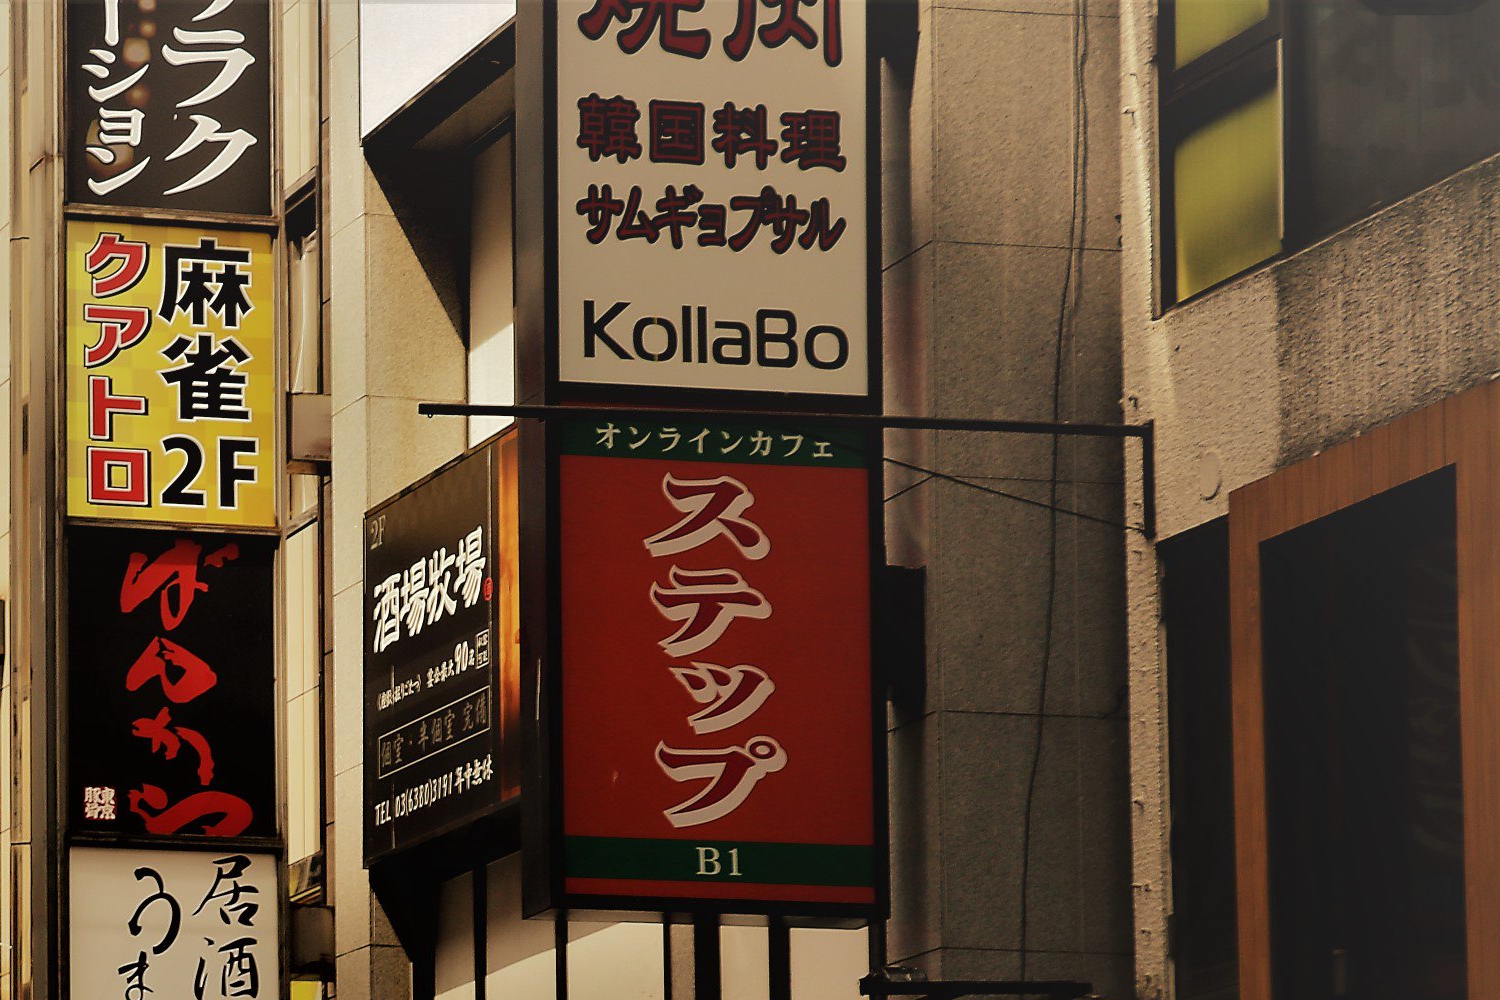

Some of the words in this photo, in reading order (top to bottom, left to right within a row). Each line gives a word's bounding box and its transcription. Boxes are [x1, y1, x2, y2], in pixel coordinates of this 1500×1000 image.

[161, 0, 258, 196] ラク
[576, 92, 847, 173] 韓国料理
[576, 184, 847, 255] サムギョプサル
[157, 235, 254, 423] 麻雀
[583, 299, 850, 371] KollaBo
[84, 231, 152, 509] クアトロ
[159, 434, 260, 511] 2F
[596, 422, 834, 459] オンラインカフェ
[643, 471, 788, 829] ステップ
[374, 802, 392, 827] TEL
[695, 847, 743, 876] B1
